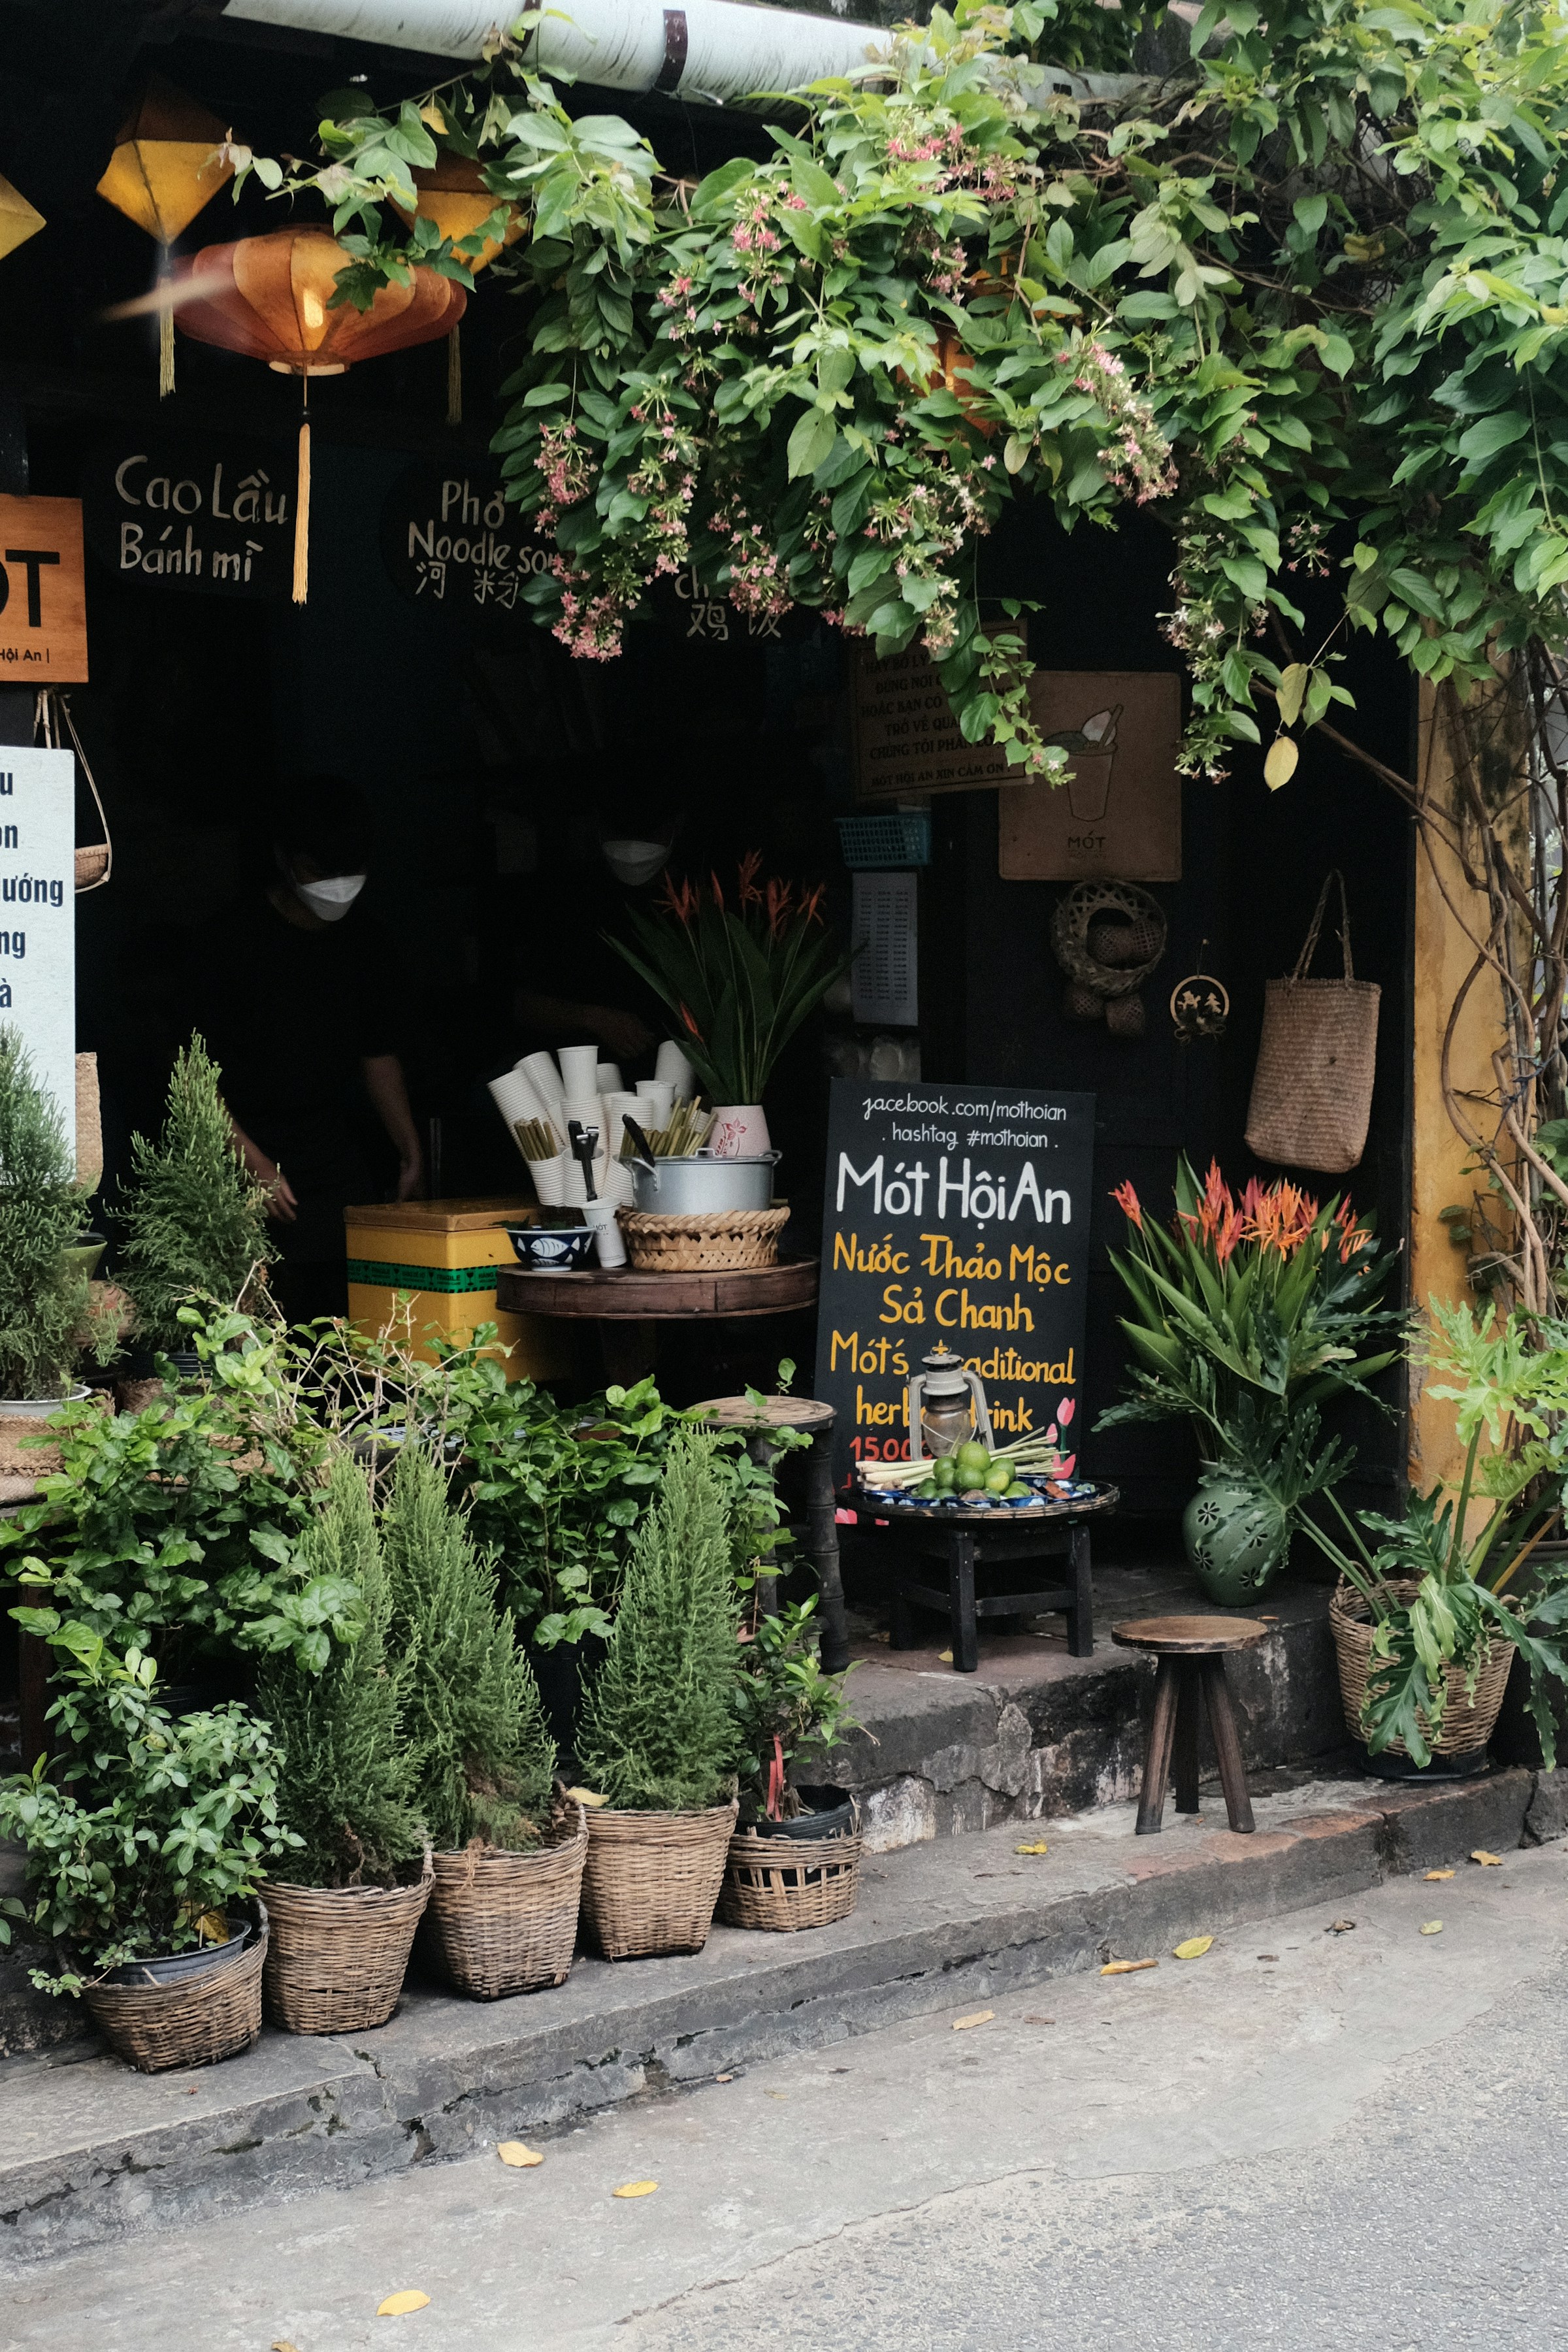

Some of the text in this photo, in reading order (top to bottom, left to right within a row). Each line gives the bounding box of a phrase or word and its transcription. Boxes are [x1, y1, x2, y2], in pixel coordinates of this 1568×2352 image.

[115, 455, 288, 525] Cao Lầu
[120, 522, 263, 582] Bánh mì
[408, 519, 511, 570] Noodle
[23, 649, 42, 661] An
[917, 771, 933, 781] AN
[1068, 830, 1107, 849] MÓT
[0, 873, 63, 907] ướng
[892, 1122, 1047, 1151] hashtag #mothoian
[836, 1152, 930, 1217] Mót
[834, 1232, 1071, 1292] Nước Thảo Mộc
[879, 1284, 1035, 1332] Sả Chanh
